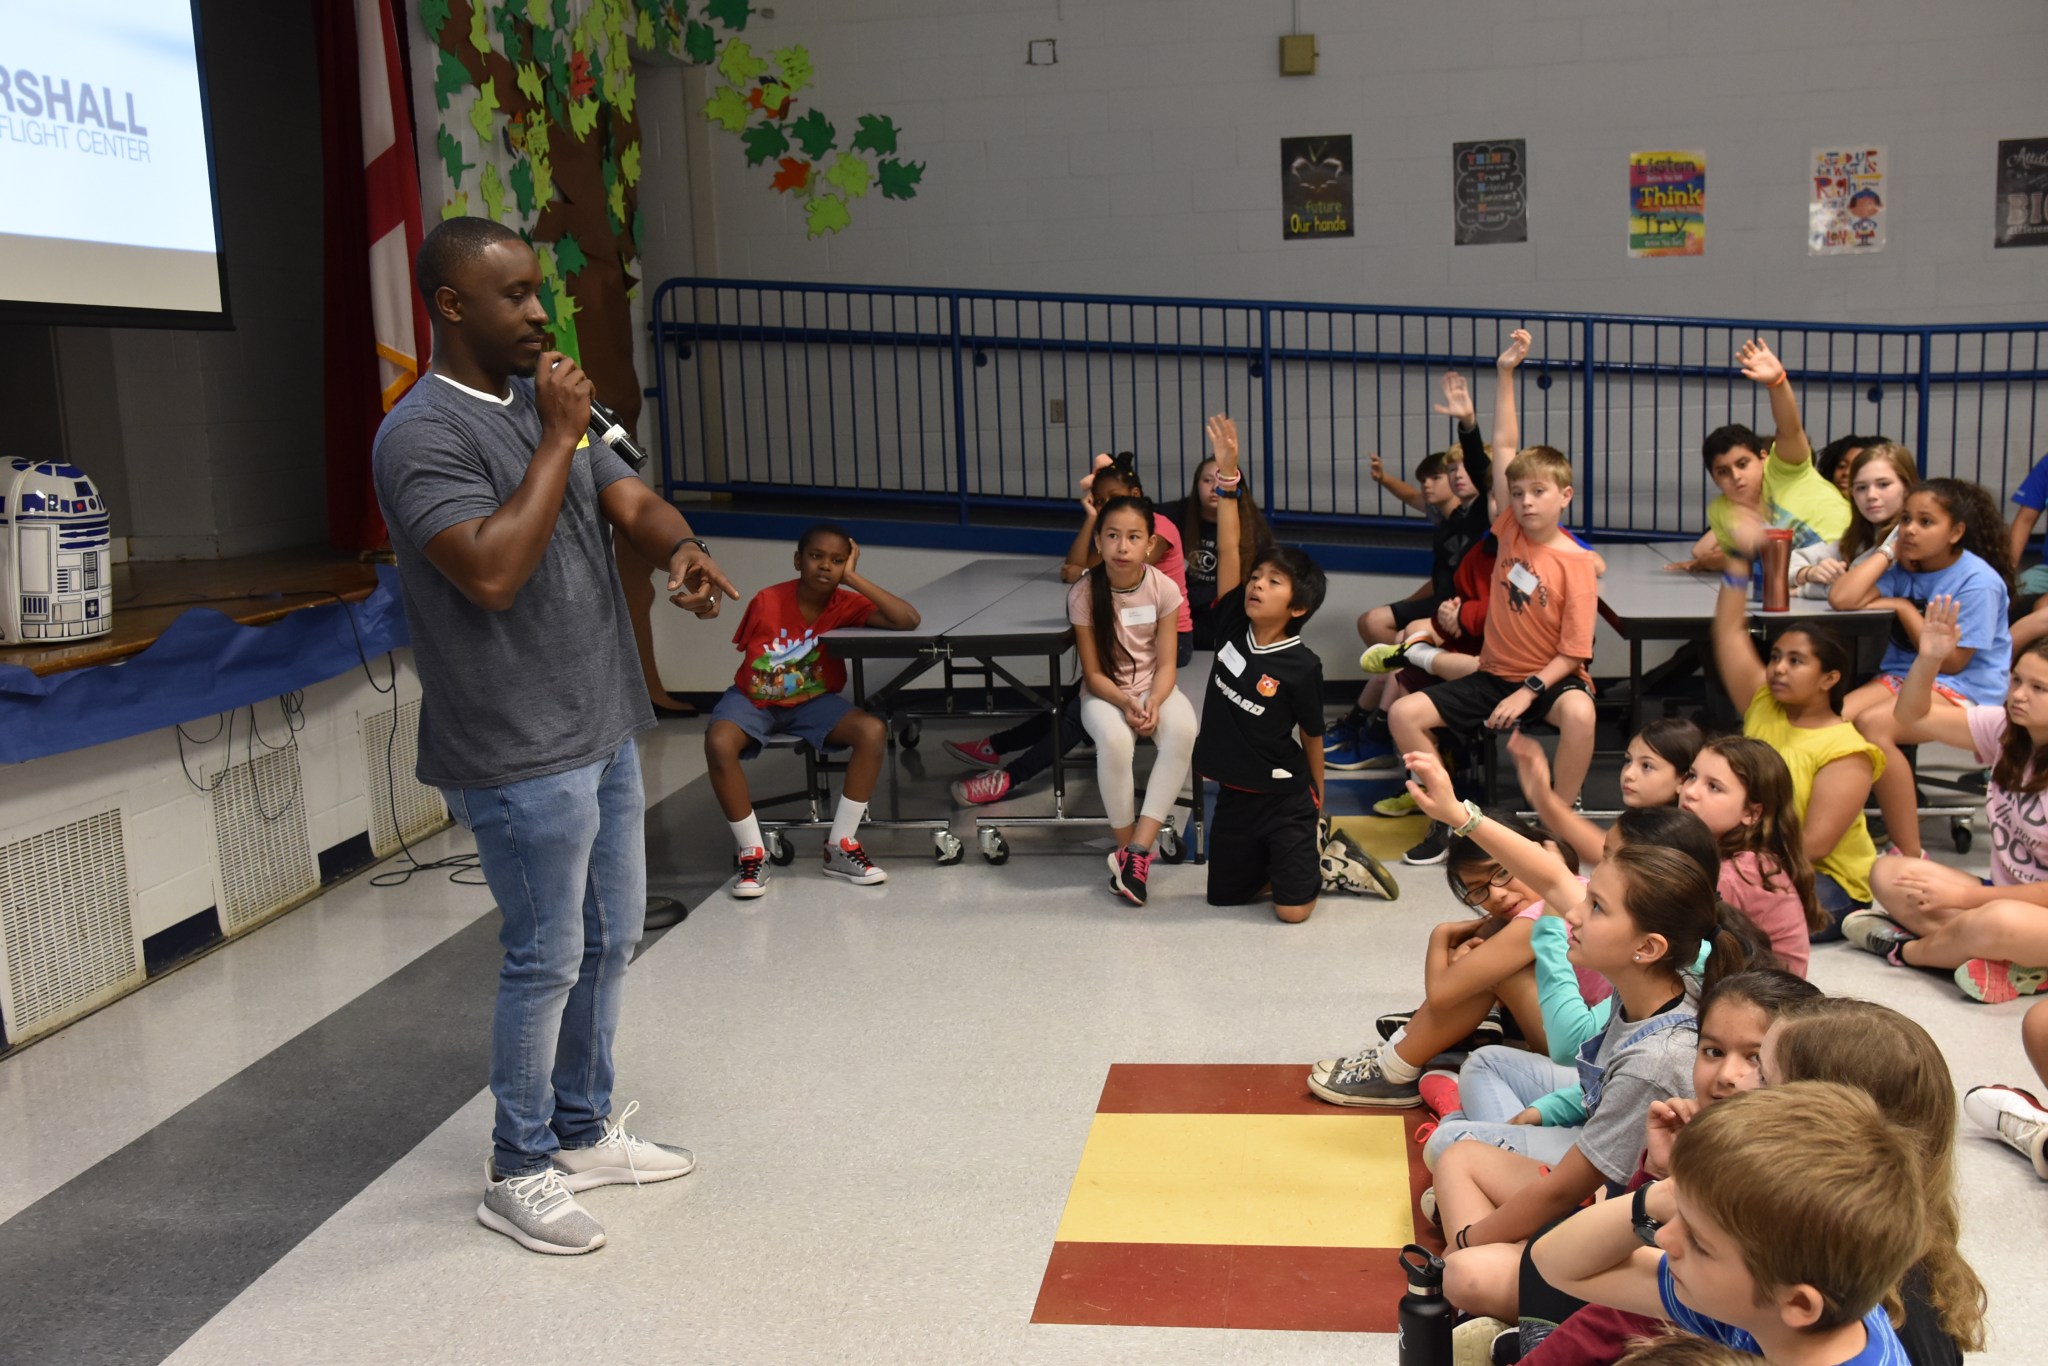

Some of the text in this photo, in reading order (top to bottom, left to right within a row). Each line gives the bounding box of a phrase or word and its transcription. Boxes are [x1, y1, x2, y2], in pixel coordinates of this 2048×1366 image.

[76, 128, 152, 164] CENTER
[1636, 156, 1697, 175] Listen
[1639, 183, 1702, 208] Think
[1305, 200, 1343, 214] future
[1290, 213, 1347, 233] Our hands
[1640, 213, 1689, 238] Try
